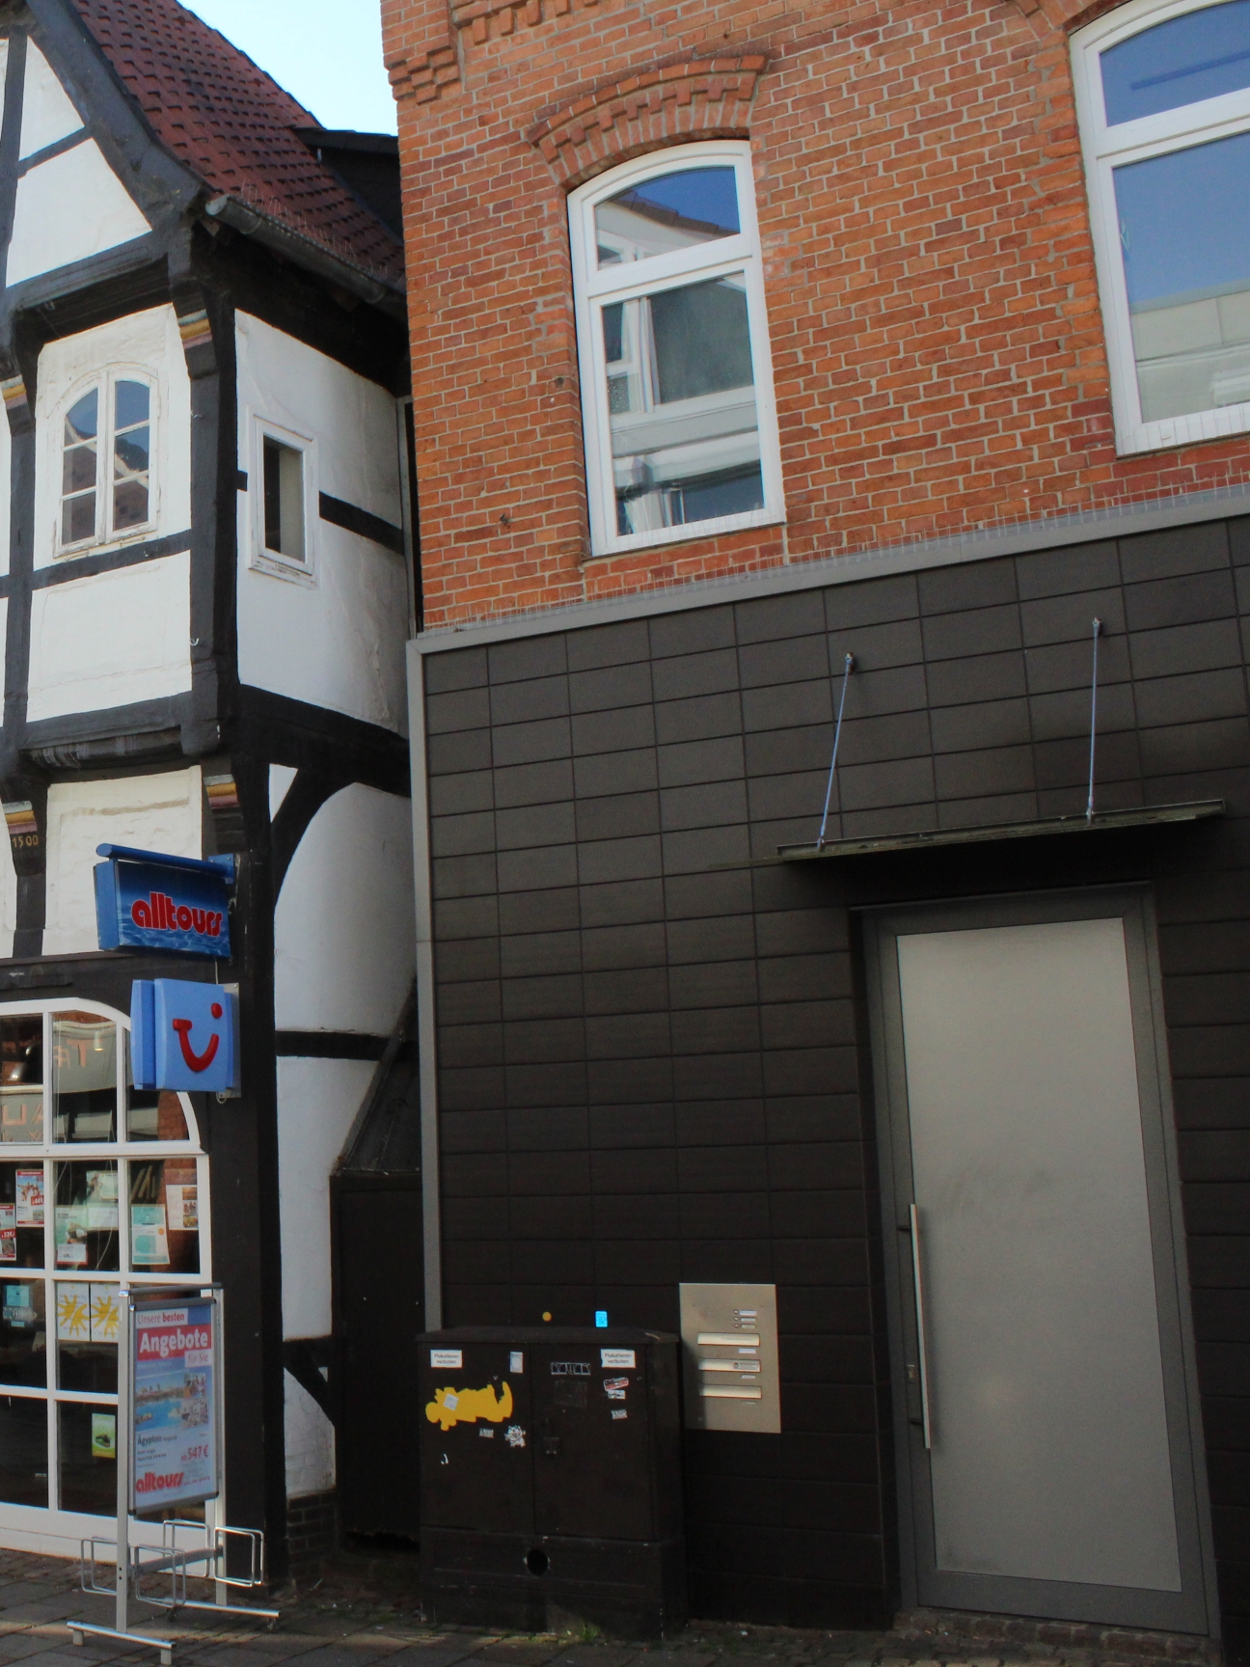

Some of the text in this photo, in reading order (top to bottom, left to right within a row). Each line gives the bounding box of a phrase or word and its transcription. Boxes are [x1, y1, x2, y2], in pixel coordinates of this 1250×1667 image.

[12, 834, 39, 848] 1500
[130, 891, 224, 937] alltours
[137, 1311, 185, 1325] Unsere besten
[139, 1328, 208, 1358] Angebote
[188, 1352, 208, 1364] für Sie
[137, 1434, 162, 1448] Ägypten
[135, 1471, 185, 1494] alltours
